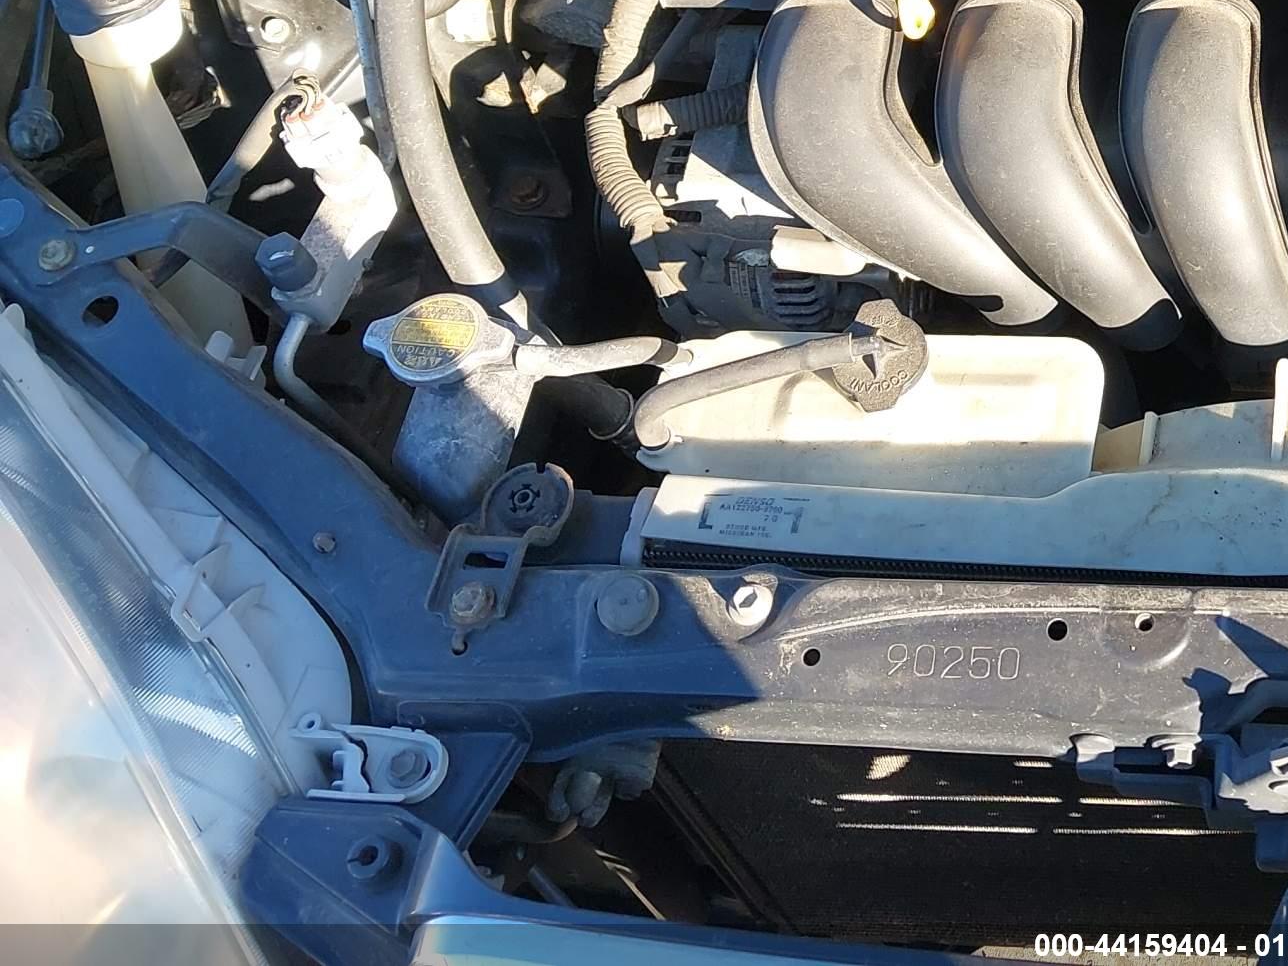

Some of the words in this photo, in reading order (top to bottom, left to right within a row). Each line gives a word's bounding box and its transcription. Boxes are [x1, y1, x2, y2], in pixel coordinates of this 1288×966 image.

[396, 344, 456, 356] CAUTION
[736, 496, 776, 506] DENSO
[887, 643, 1020, 680] 90250
